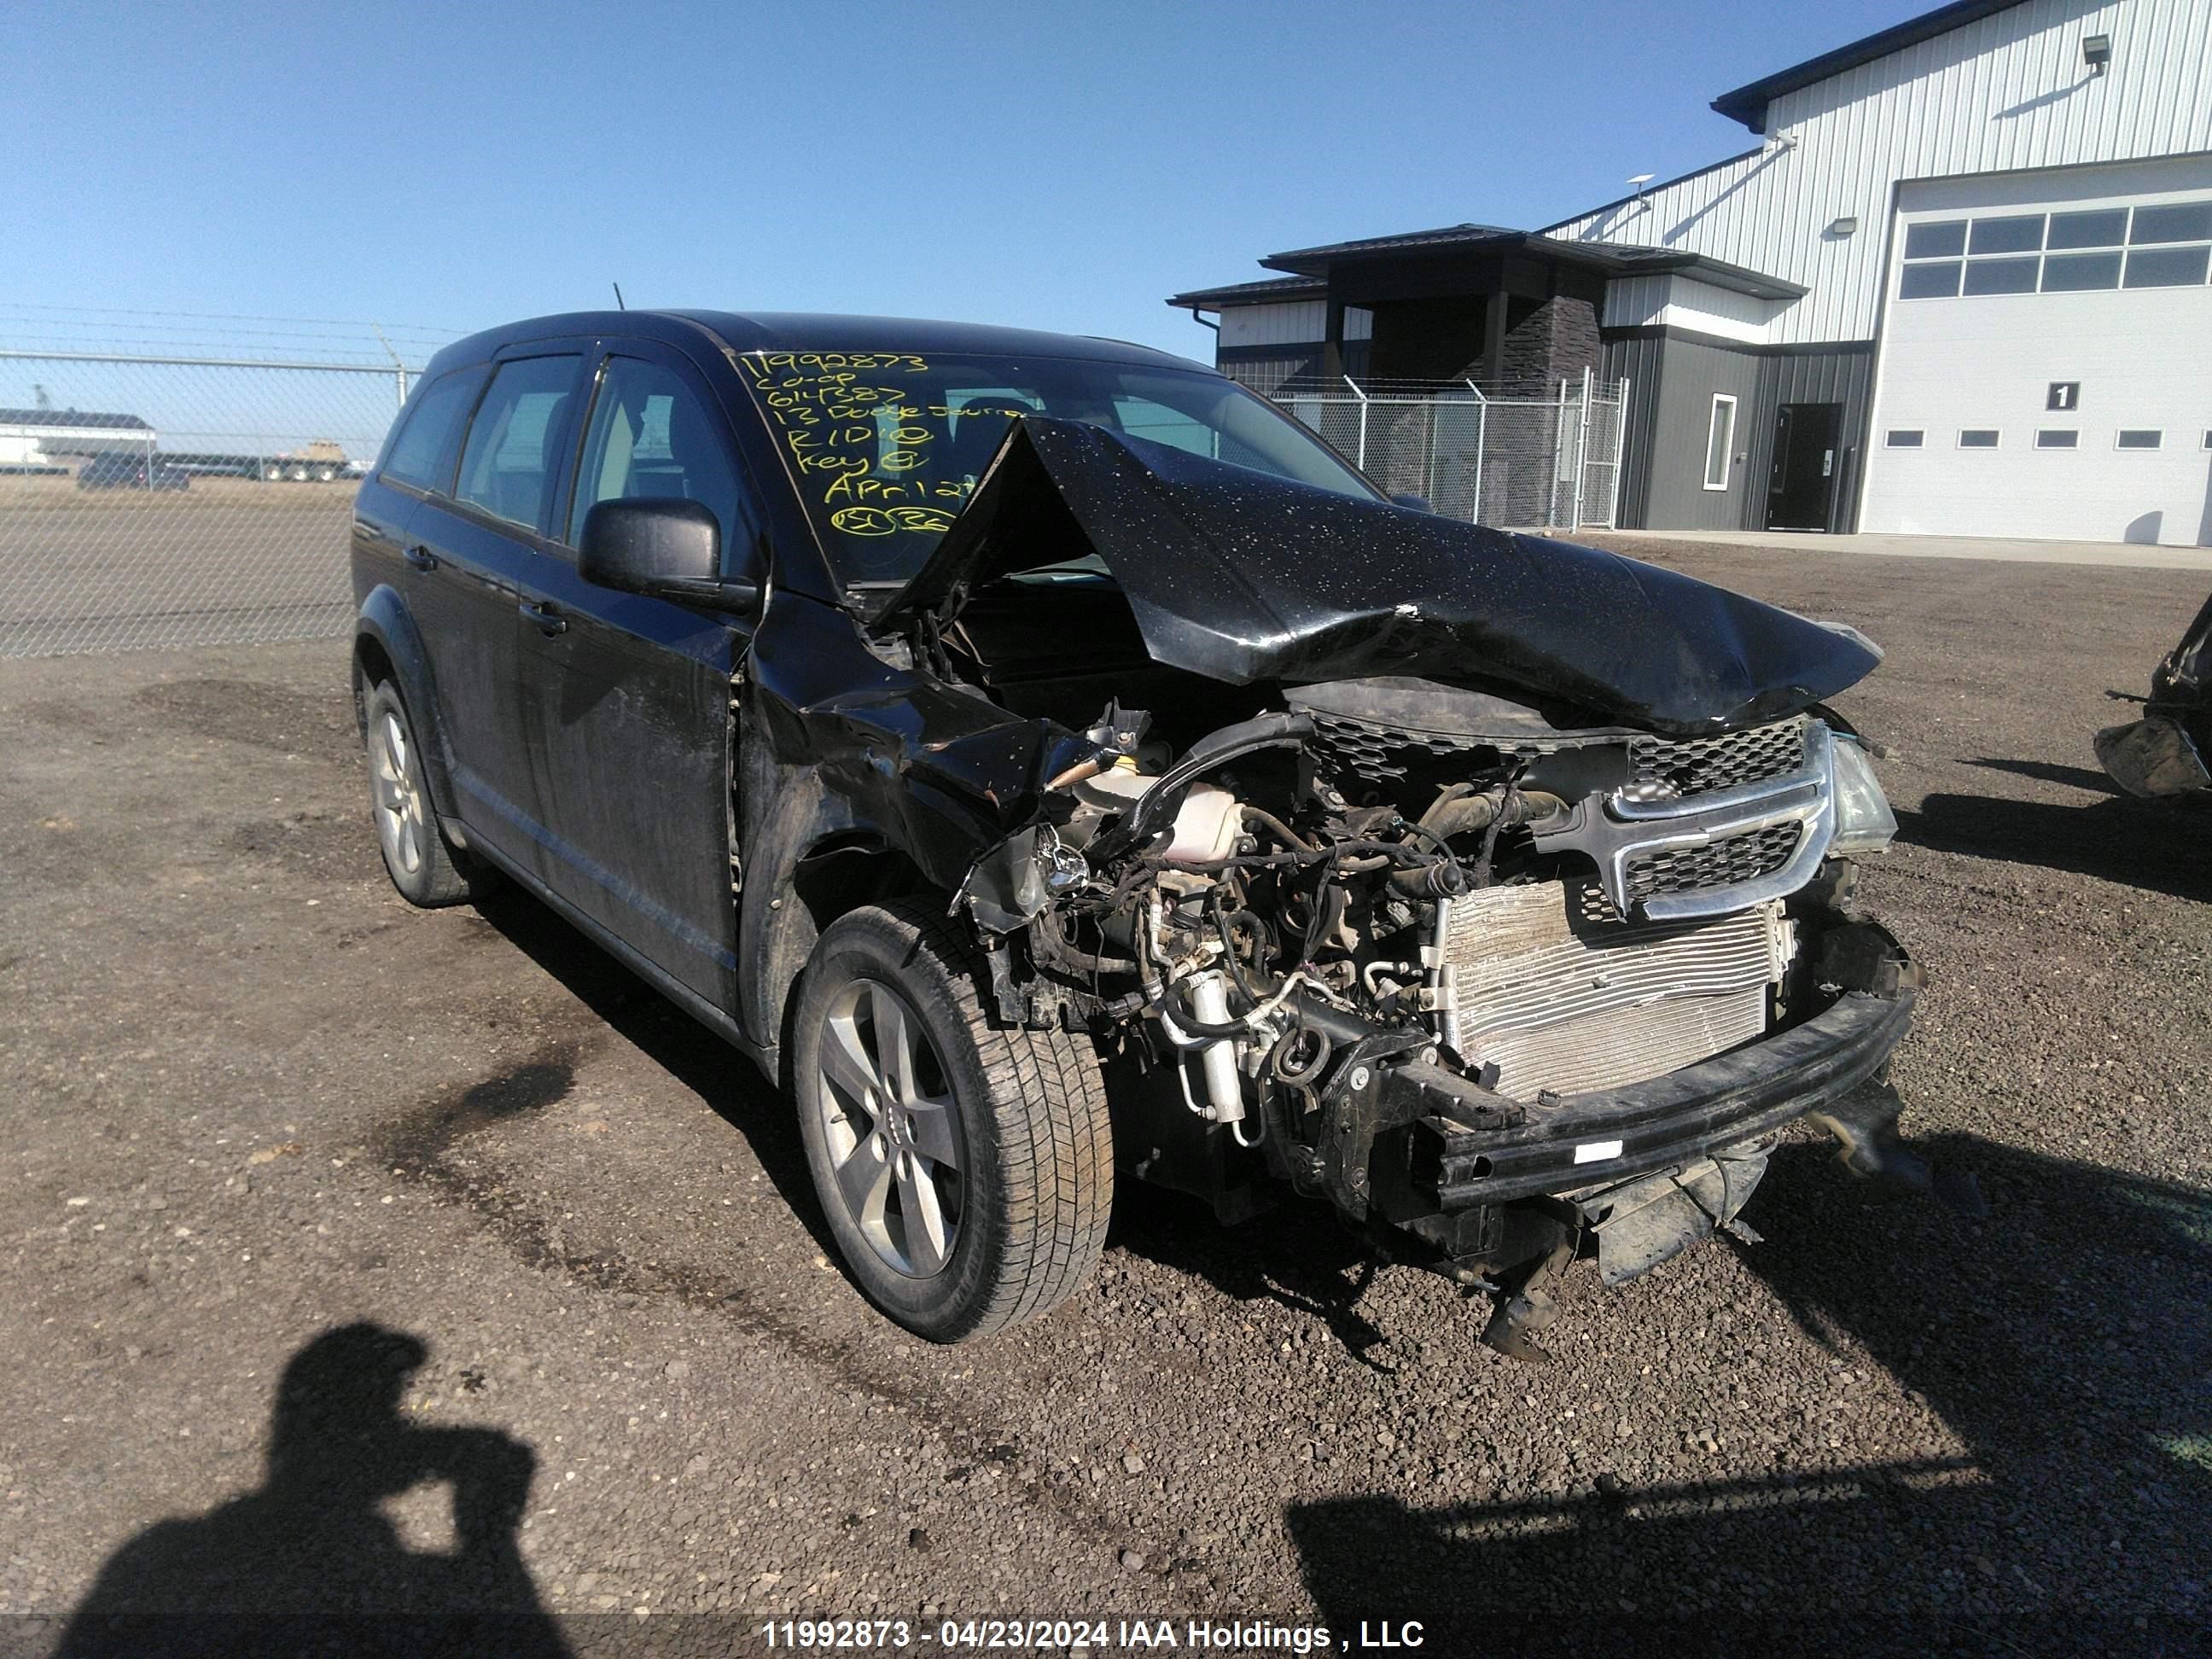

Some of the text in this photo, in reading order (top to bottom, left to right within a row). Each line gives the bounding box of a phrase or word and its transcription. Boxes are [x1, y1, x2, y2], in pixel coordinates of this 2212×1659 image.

[741, 354, 929, 378] 11992873
[767, 387, 906, 407] 614387
[2057, 386, 2069, 407] 1
[773, 407, 820, 425] 13
